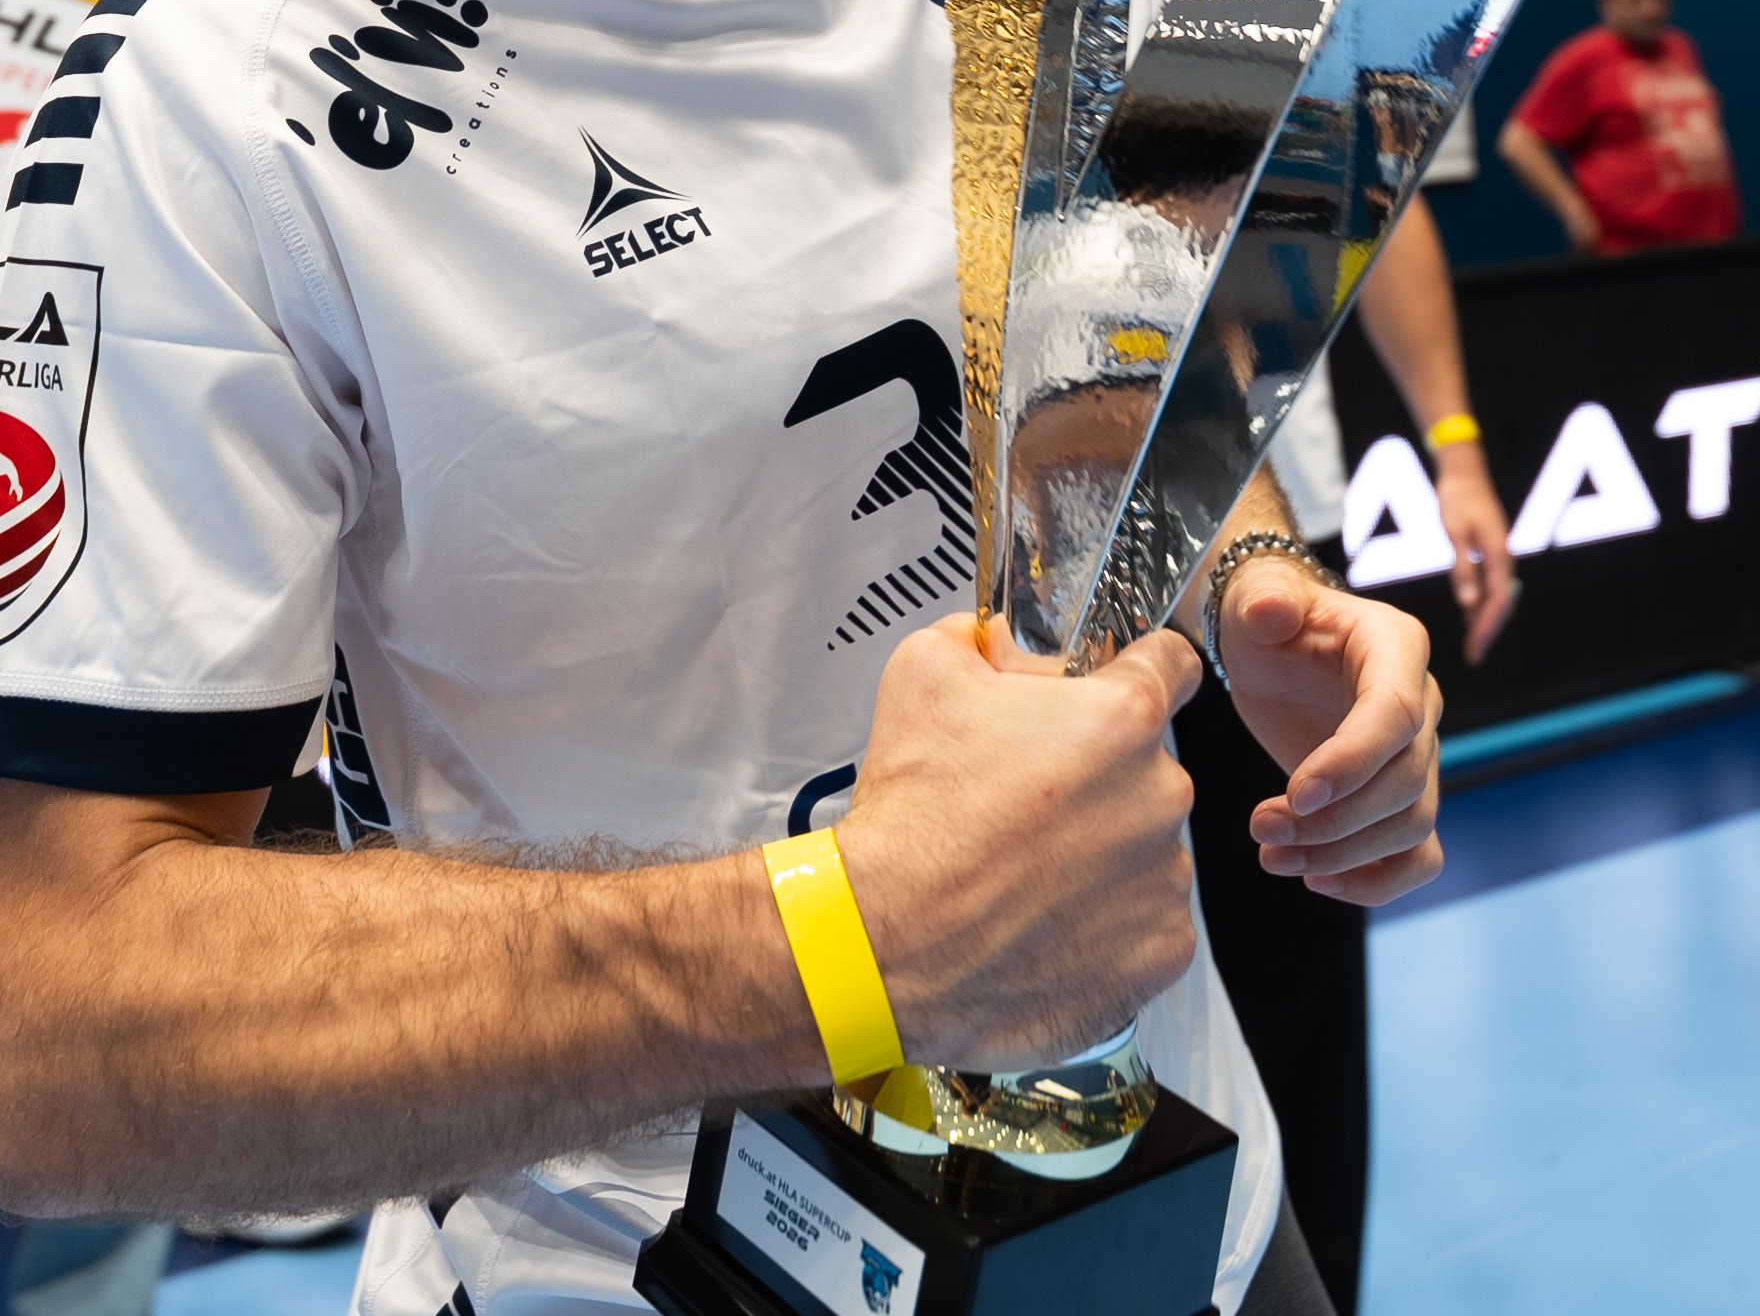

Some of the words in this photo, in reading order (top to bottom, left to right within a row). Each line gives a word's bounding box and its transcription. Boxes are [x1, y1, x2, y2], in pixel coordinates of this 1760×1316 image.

[446, 48, 517, 175] creations
[583, 206, 712, 278] SELECT
[738, 1147, 777, 1185] druck.at
[778, 1178, 798, 1203] HLA
[800, 1195, 852, 1243] SUPERCUP
[763, 1189, 820, 1241] SIEGER
[766, 1209, 809, 1252] 2026
